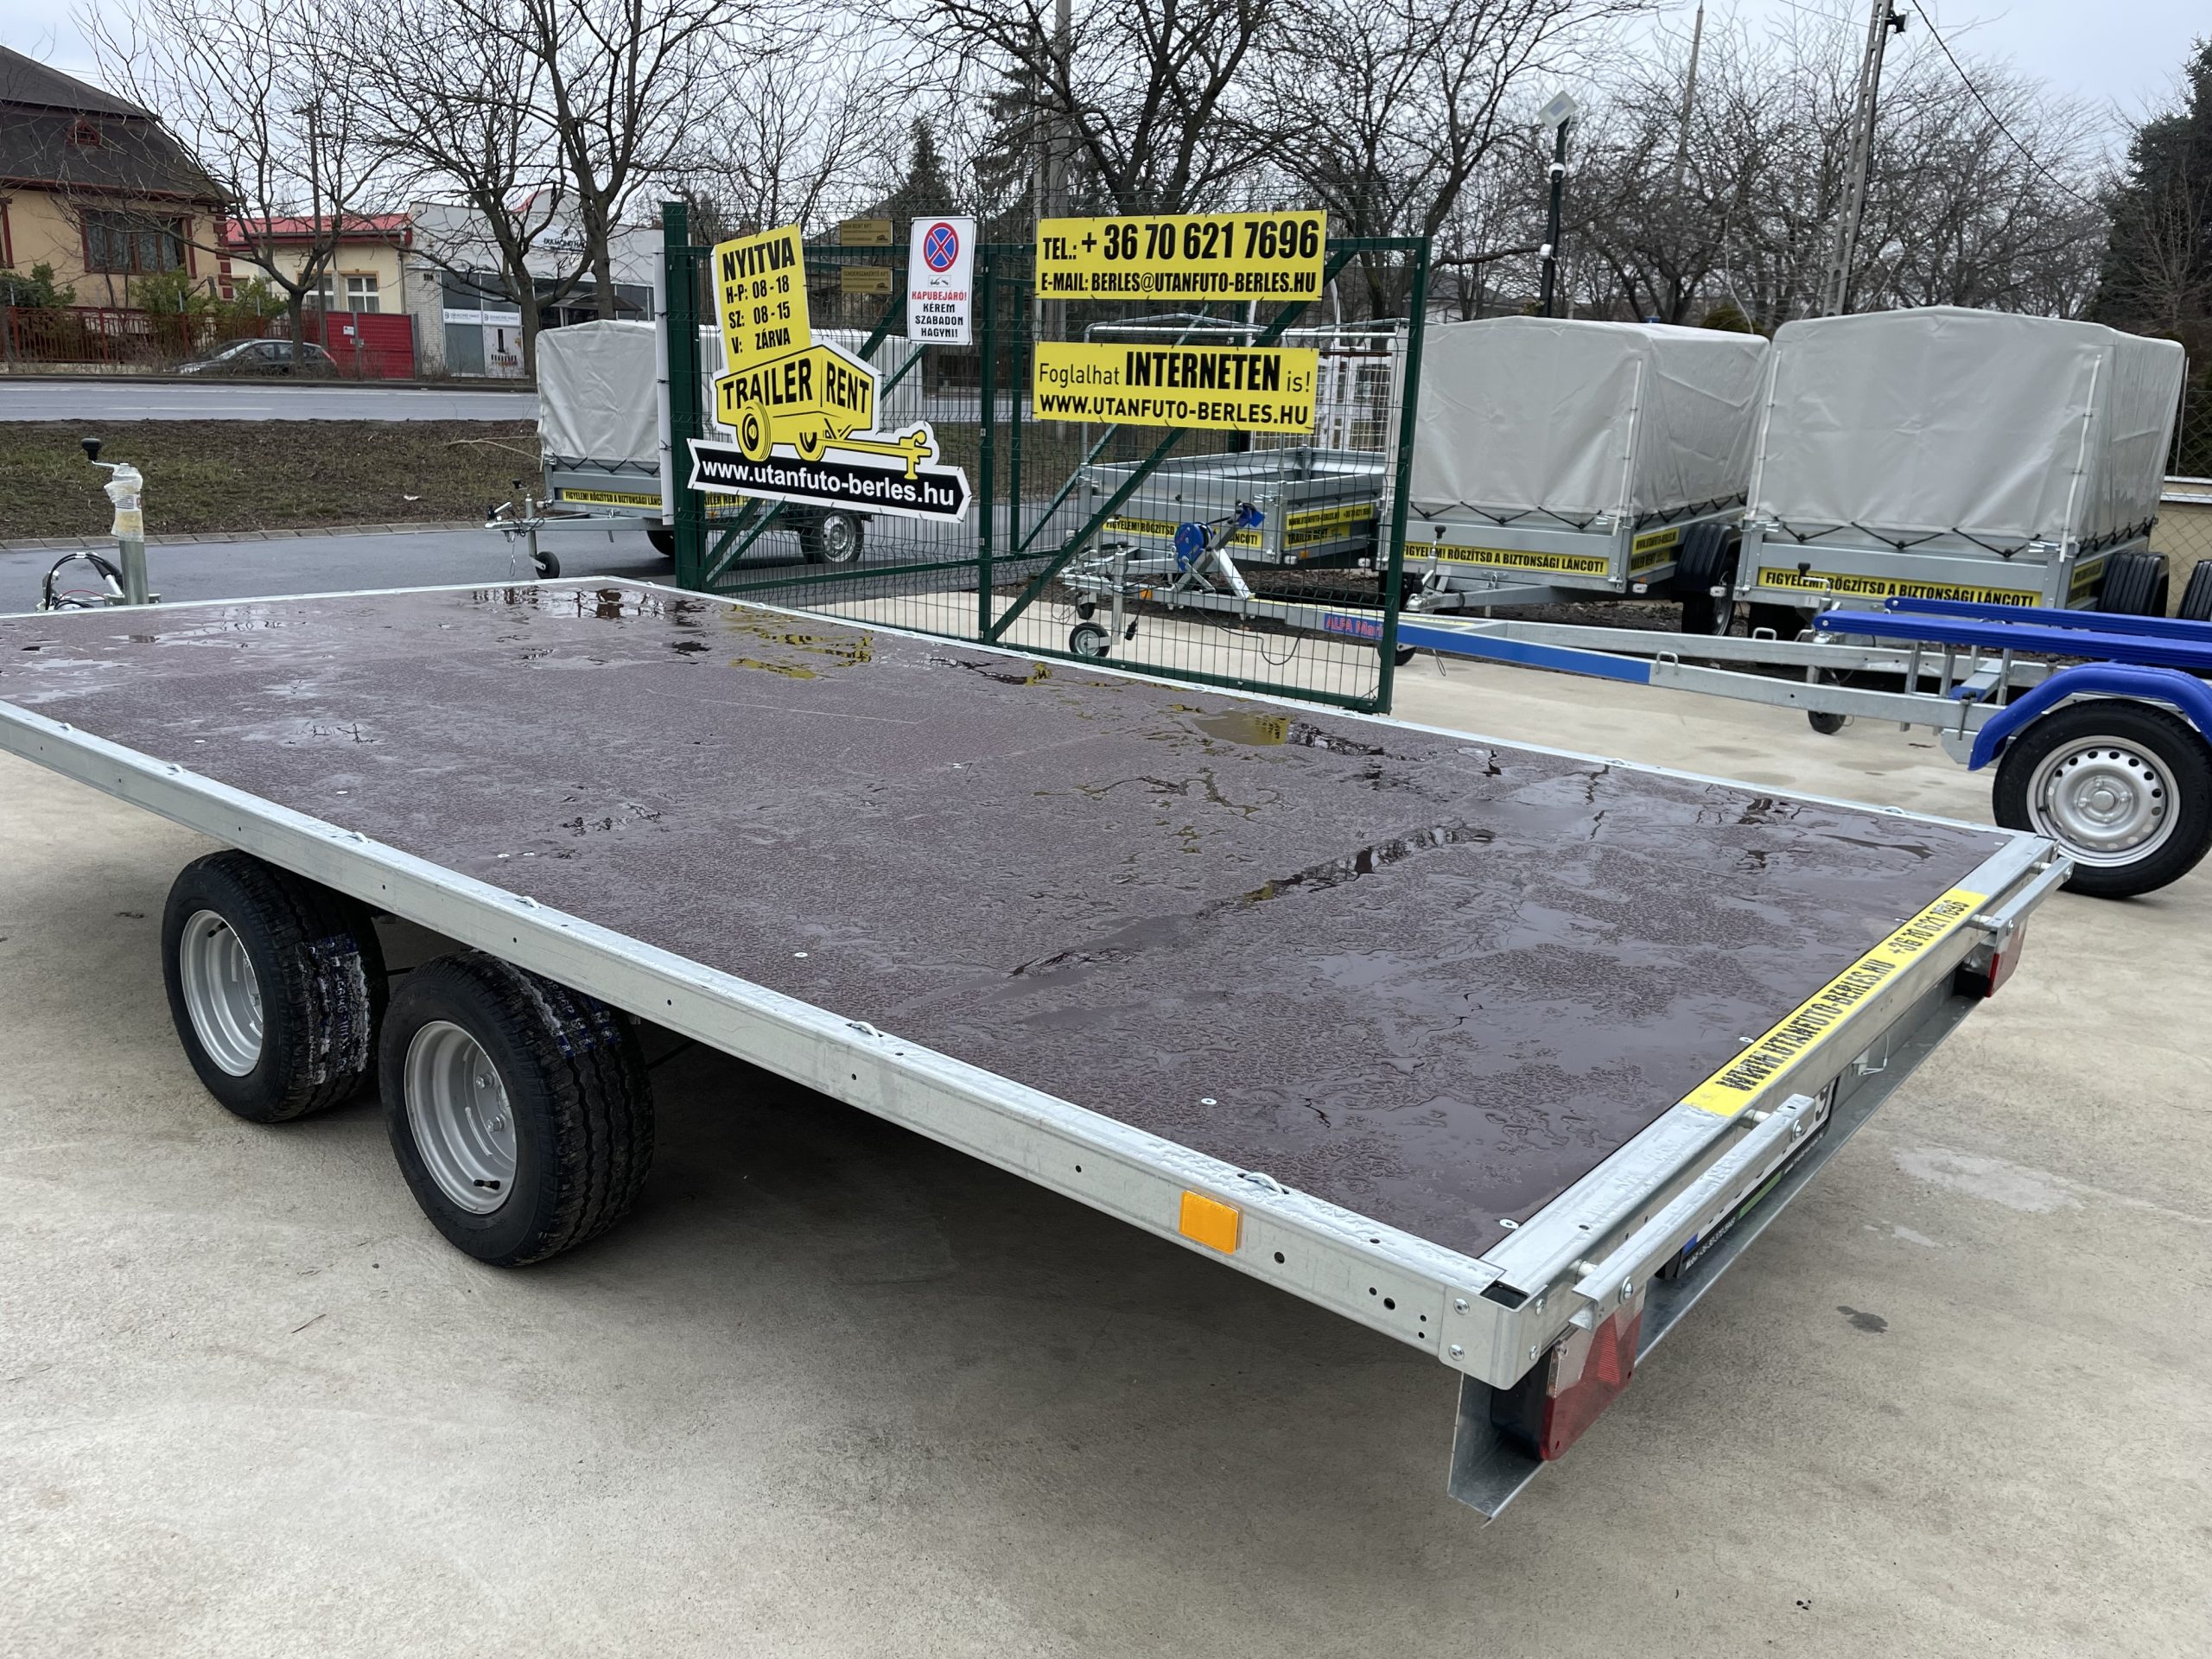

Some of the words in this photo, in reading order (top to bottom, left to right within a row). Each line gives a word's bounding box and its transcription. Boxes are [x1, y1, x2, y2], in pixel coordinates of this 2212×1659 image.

[1043, 237, 1077, 260] TEL.:
[1104, 224, 1138, 260] 36
[1145, 223, 1175, 259] 70
[1183, 221, 1234, 259] 621
[1244, 219, 1319, 259] 7696
[723, 237, 795, 283] NYITVA
[726, 288, 747, 304] H-P:
[752, 281, 767, 299] 08
[776, 274, 790, 292] 18
[912, 289, 967, 301] KAPUBEJÁRÓ!
[1041, 272, 1089, 291] E-MAIL:
[1091, 271, 1317, 293] BERLES@UTANFUTO-BERLES.HU
[728, 312, 745, 329] SZ:
[753, 307, 768, 325] 08
[777, 301, 791, 319] 15
[915, 315, 963, 326] SZABADON
[923, 302, 956, 313] KÉREM
[732, 336, 743, 354] V:
[755, 327, 791, 351] ZÁRVA
[921, 327, 958, 338] HAGYNI!
[723, 358, 813, 410] TRAILER
[826, 360, 869, 414] RENT
[1039, 363, 1120, 388] Foglalhat
[1126, 351, 1281, 391] INTERNETEN
[1287, 371, 1311, 393] is!
[1039, 394, 1309, 425] WWW.UTANFUTO-BERLES.HU
[702, 460, 954, 506] www.utanfuto-berles.hu
[1447, 548, 1492, 563] RÖGZÍTSD
[1494, 554, 1501, 563] A
[1503, 553, 1560, 569] BIZTONSÁGI
[1561, 557, 1604, 573] LÁNCOT!
[1827, 575, 1885, 594] RÖGZÍTSD
[1887, 582, 1896, 595] A
[1899, 584, 1974, 603] BIZTONSÁGI
[1326, 615, 1353, 633] ALFA
[1356, 621, 1383, 638] Mari
[1716, 958, 1896, 1091] WWW.UTANFUTO-BERLES.HU
